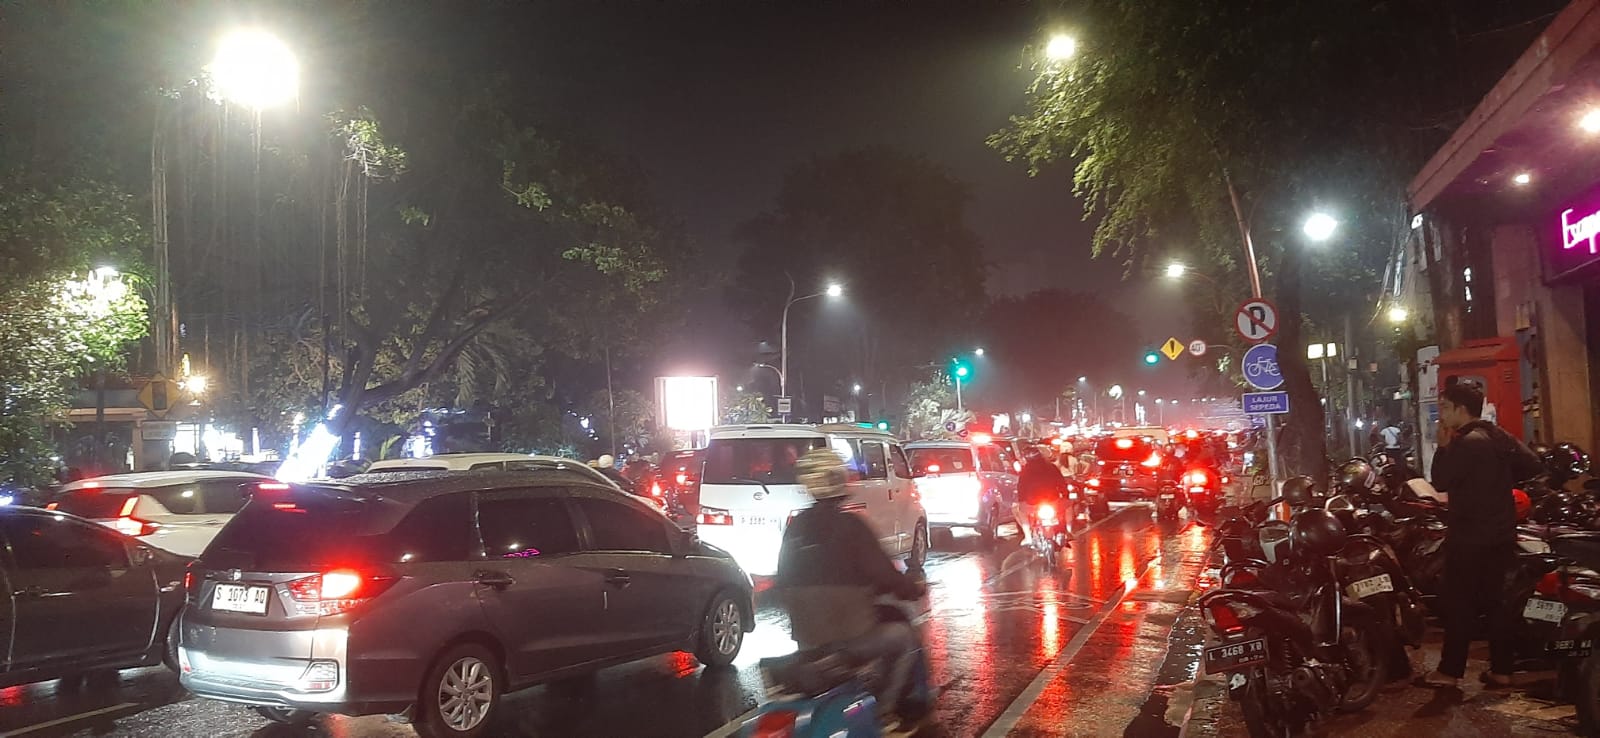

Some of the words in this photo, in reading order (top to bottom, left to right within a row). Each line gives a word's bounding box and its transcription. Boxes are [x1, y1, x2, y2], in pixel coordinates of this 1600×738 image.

[1249, 305, 1266, 335] P
[1251, 395, 1278, 403] LAJUR
[1249, 403, 1281, 411] SEPEDA
[216, 587, 222, 600] S
[1209, 652, 1216, 661] L
